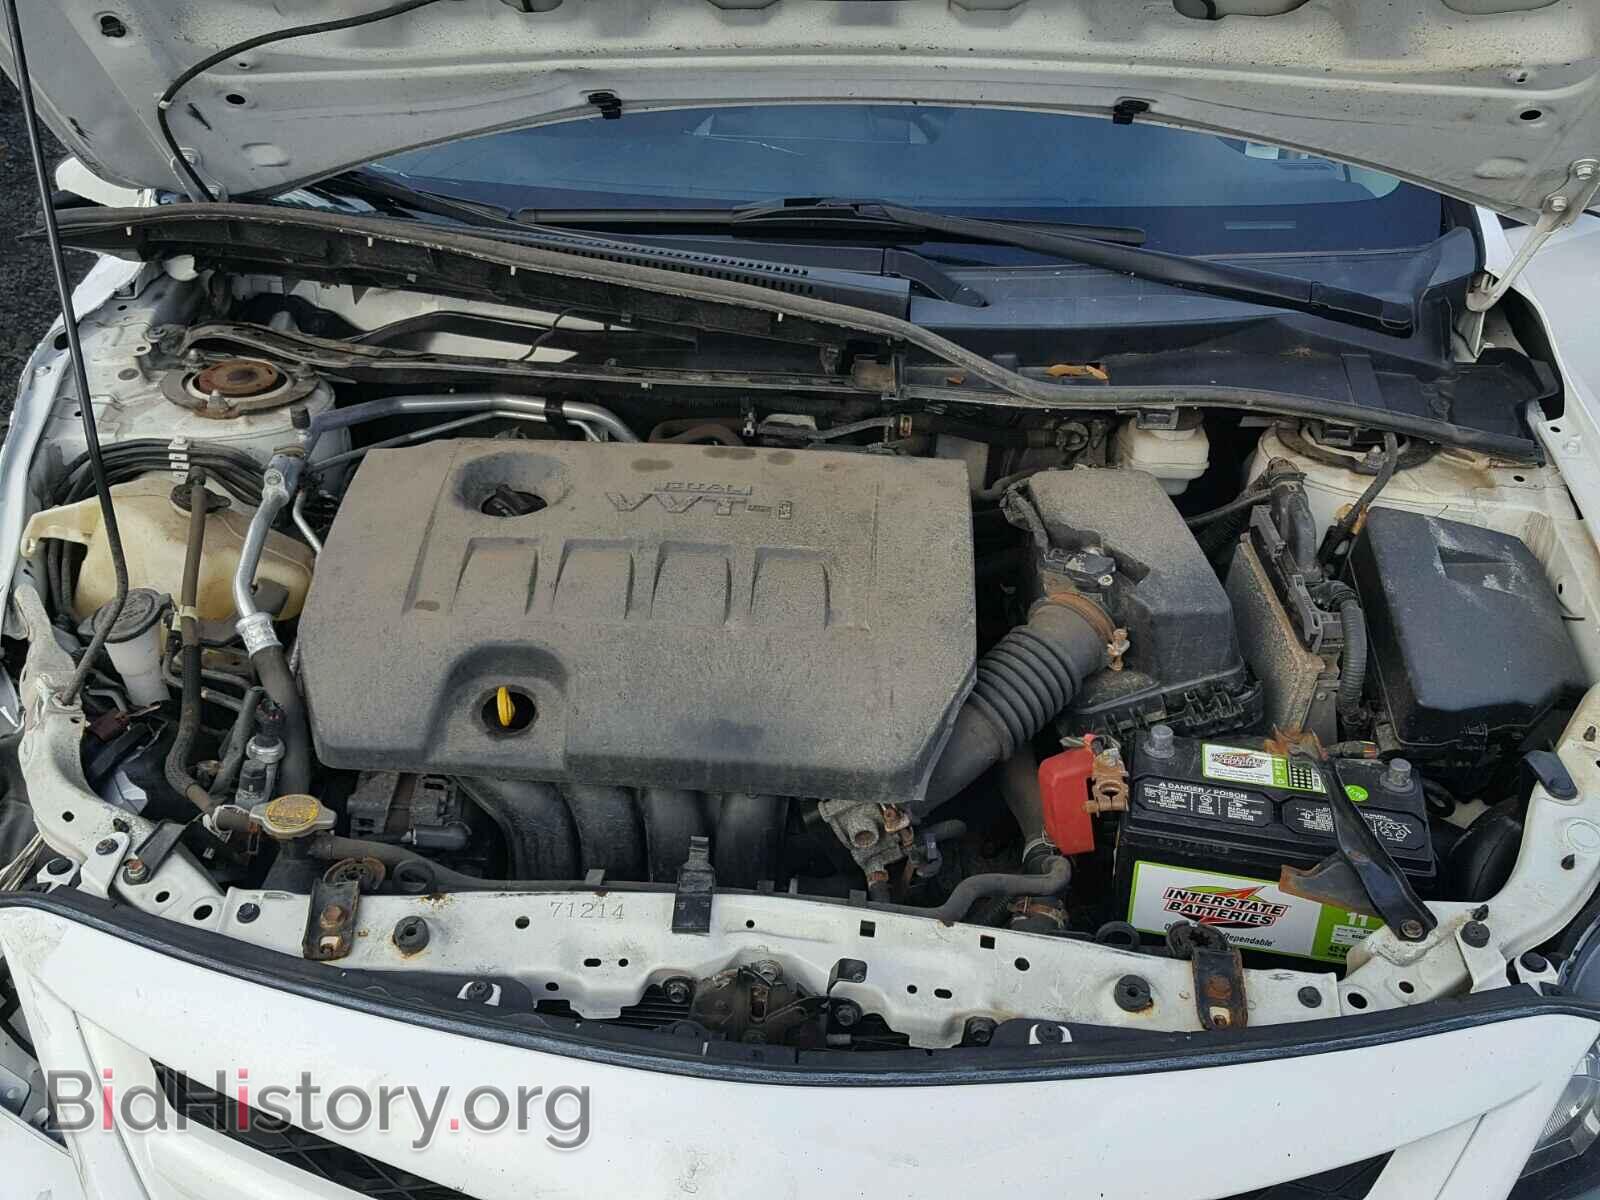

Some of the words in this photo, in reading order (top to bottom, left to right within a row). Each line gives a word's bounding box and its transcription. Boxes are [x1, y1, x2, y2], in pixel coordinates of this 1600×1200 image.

[1167, 782, 1204, 794] DANGER
[1213, 789, 1248, 800] POISON
[549, 901, 625, 920] 71214
[1166, 888, 1285, 916] INTERSTATE
[1168, 901, 1274, 925] BATTERIES
